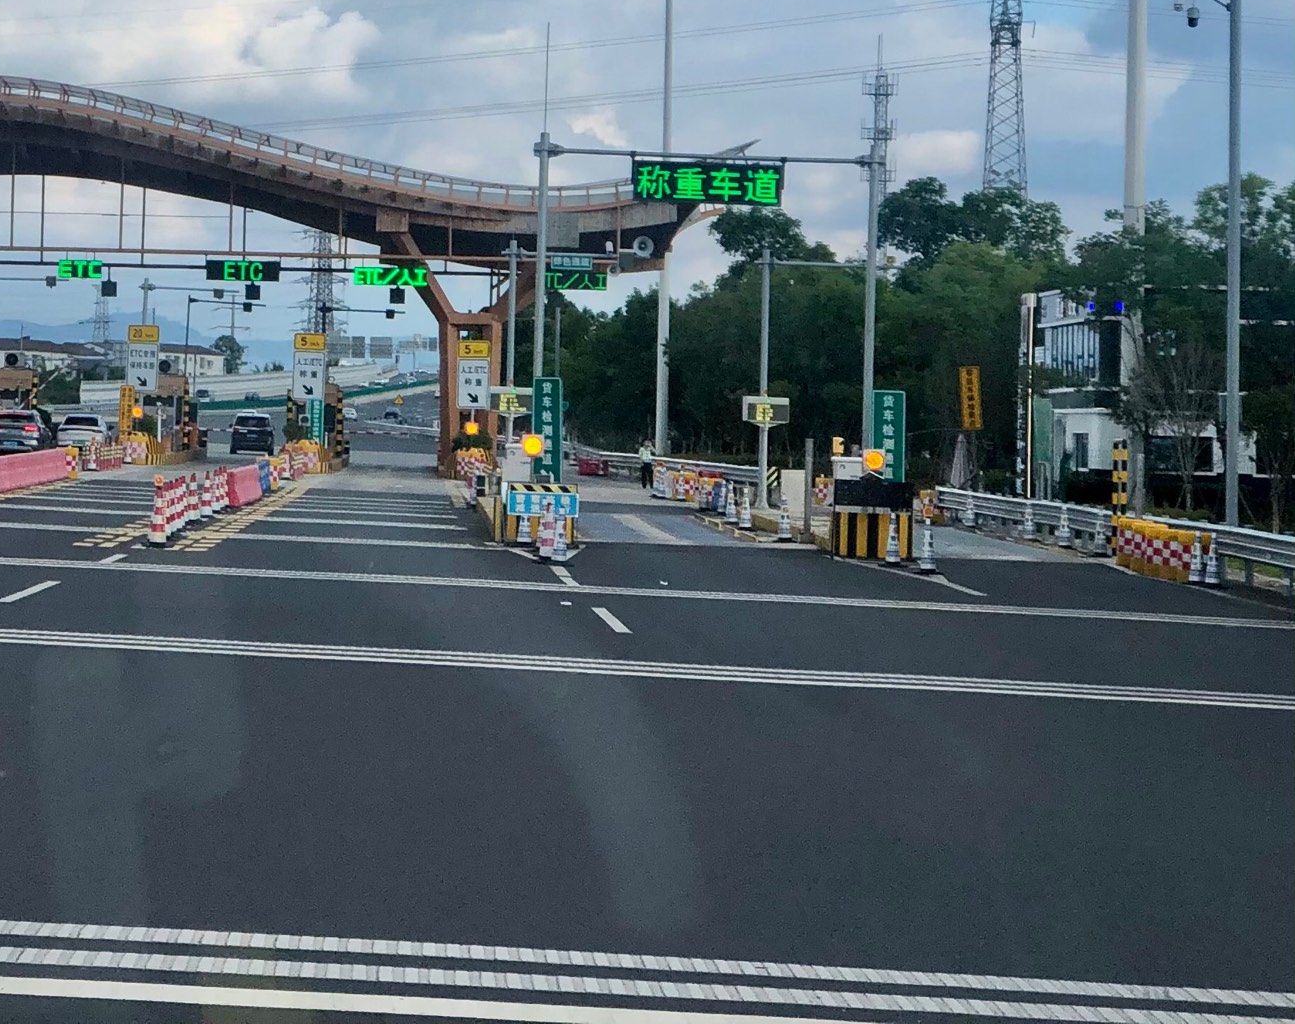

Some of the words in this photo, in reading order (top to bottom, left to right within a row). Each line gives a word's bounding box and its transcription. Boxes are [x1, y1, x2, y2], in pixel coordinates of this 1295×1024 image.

[637, 165, 780, 204] 称重车道
[58, 260, 102, 278] ETC
[224, 261, 263, 281] ETC
[354, 267, 428, 286] ETC/人工
[545, 272, 607, 290] TC/人工
[300, 336, 308, 347] 5
[464, 344, 472, 355] 5
